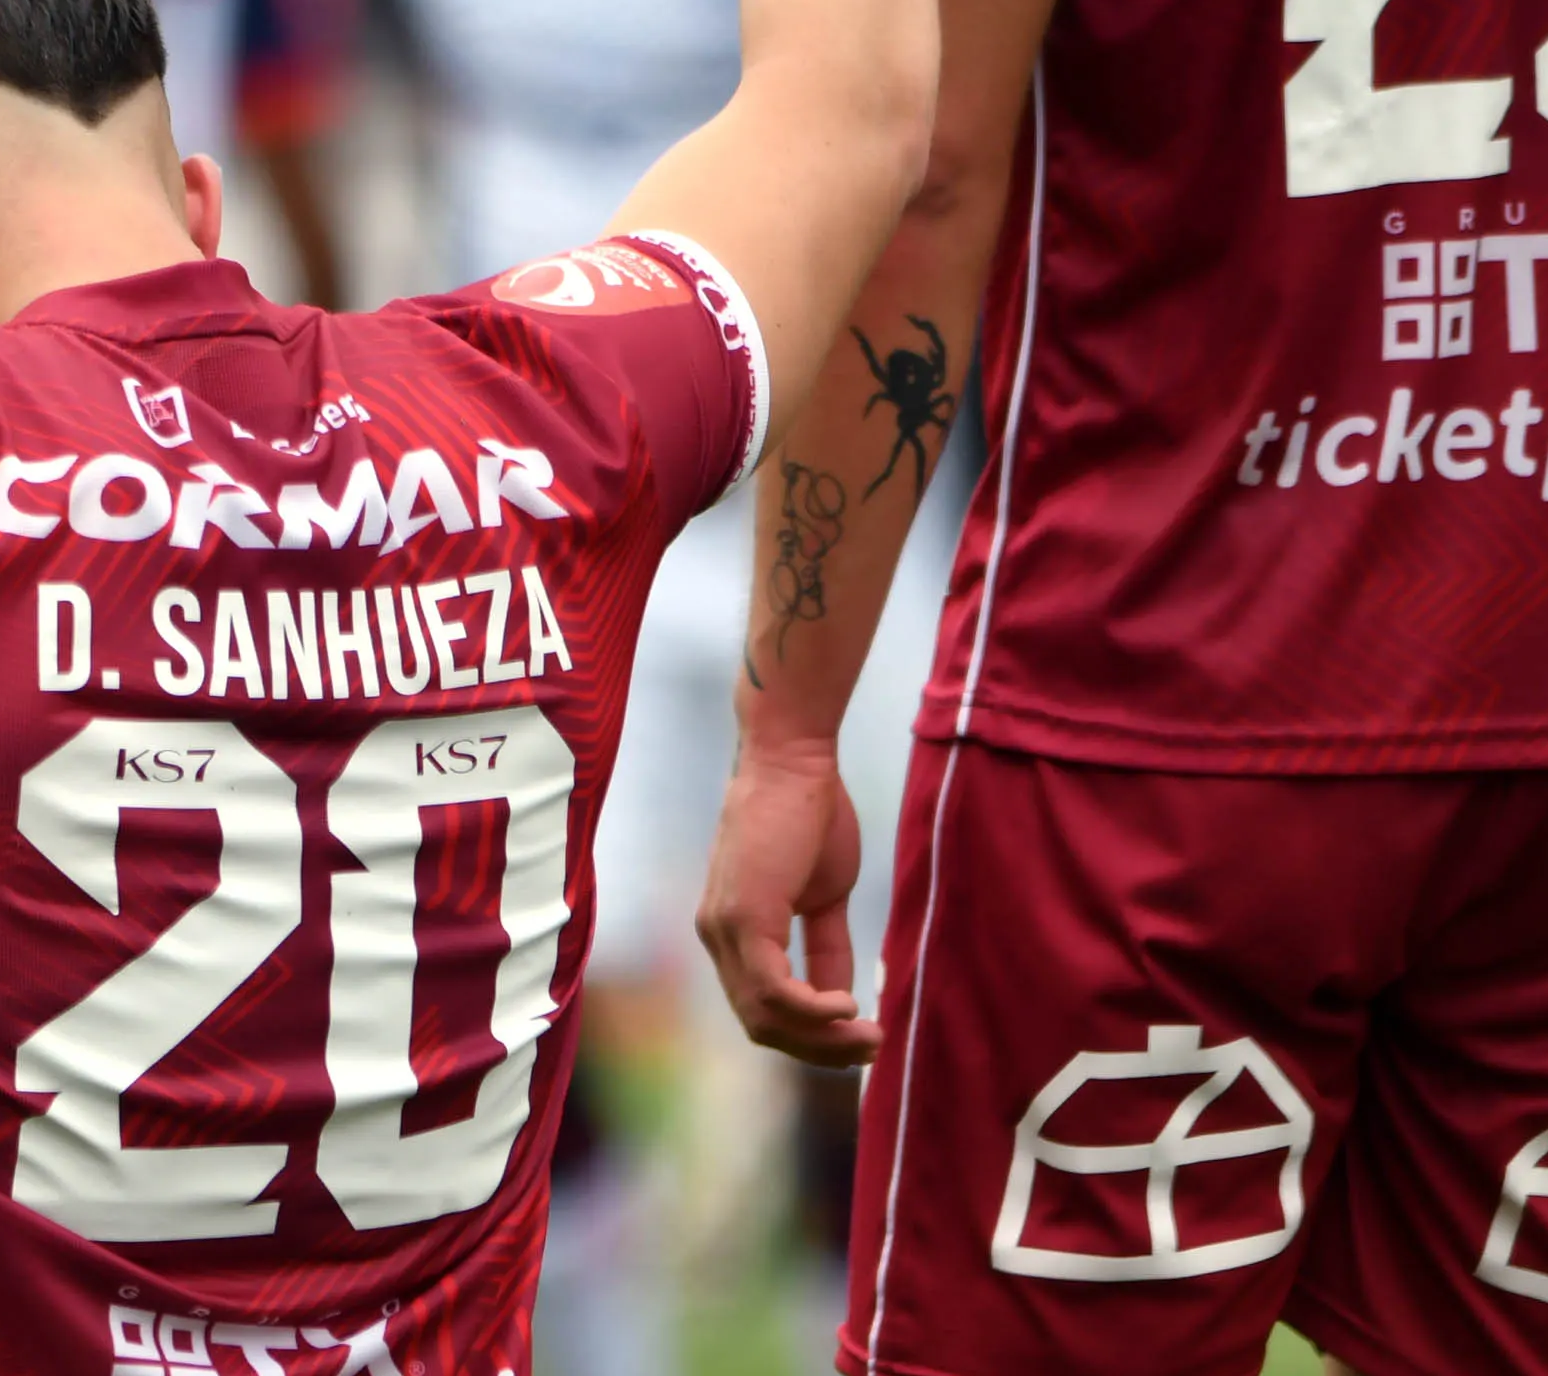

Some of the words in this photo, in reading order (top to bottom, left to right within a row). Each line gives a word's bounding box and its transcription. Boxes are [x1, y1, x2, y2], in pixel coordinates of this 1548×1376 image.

[37, 583, 121, 694] D.
[154, 567, 573, 699] SANHUEZA
[114, 748, 215, 785] KS7
[414, 735, 508, 777] KS7
[11, 705, 576, 1242] 20
